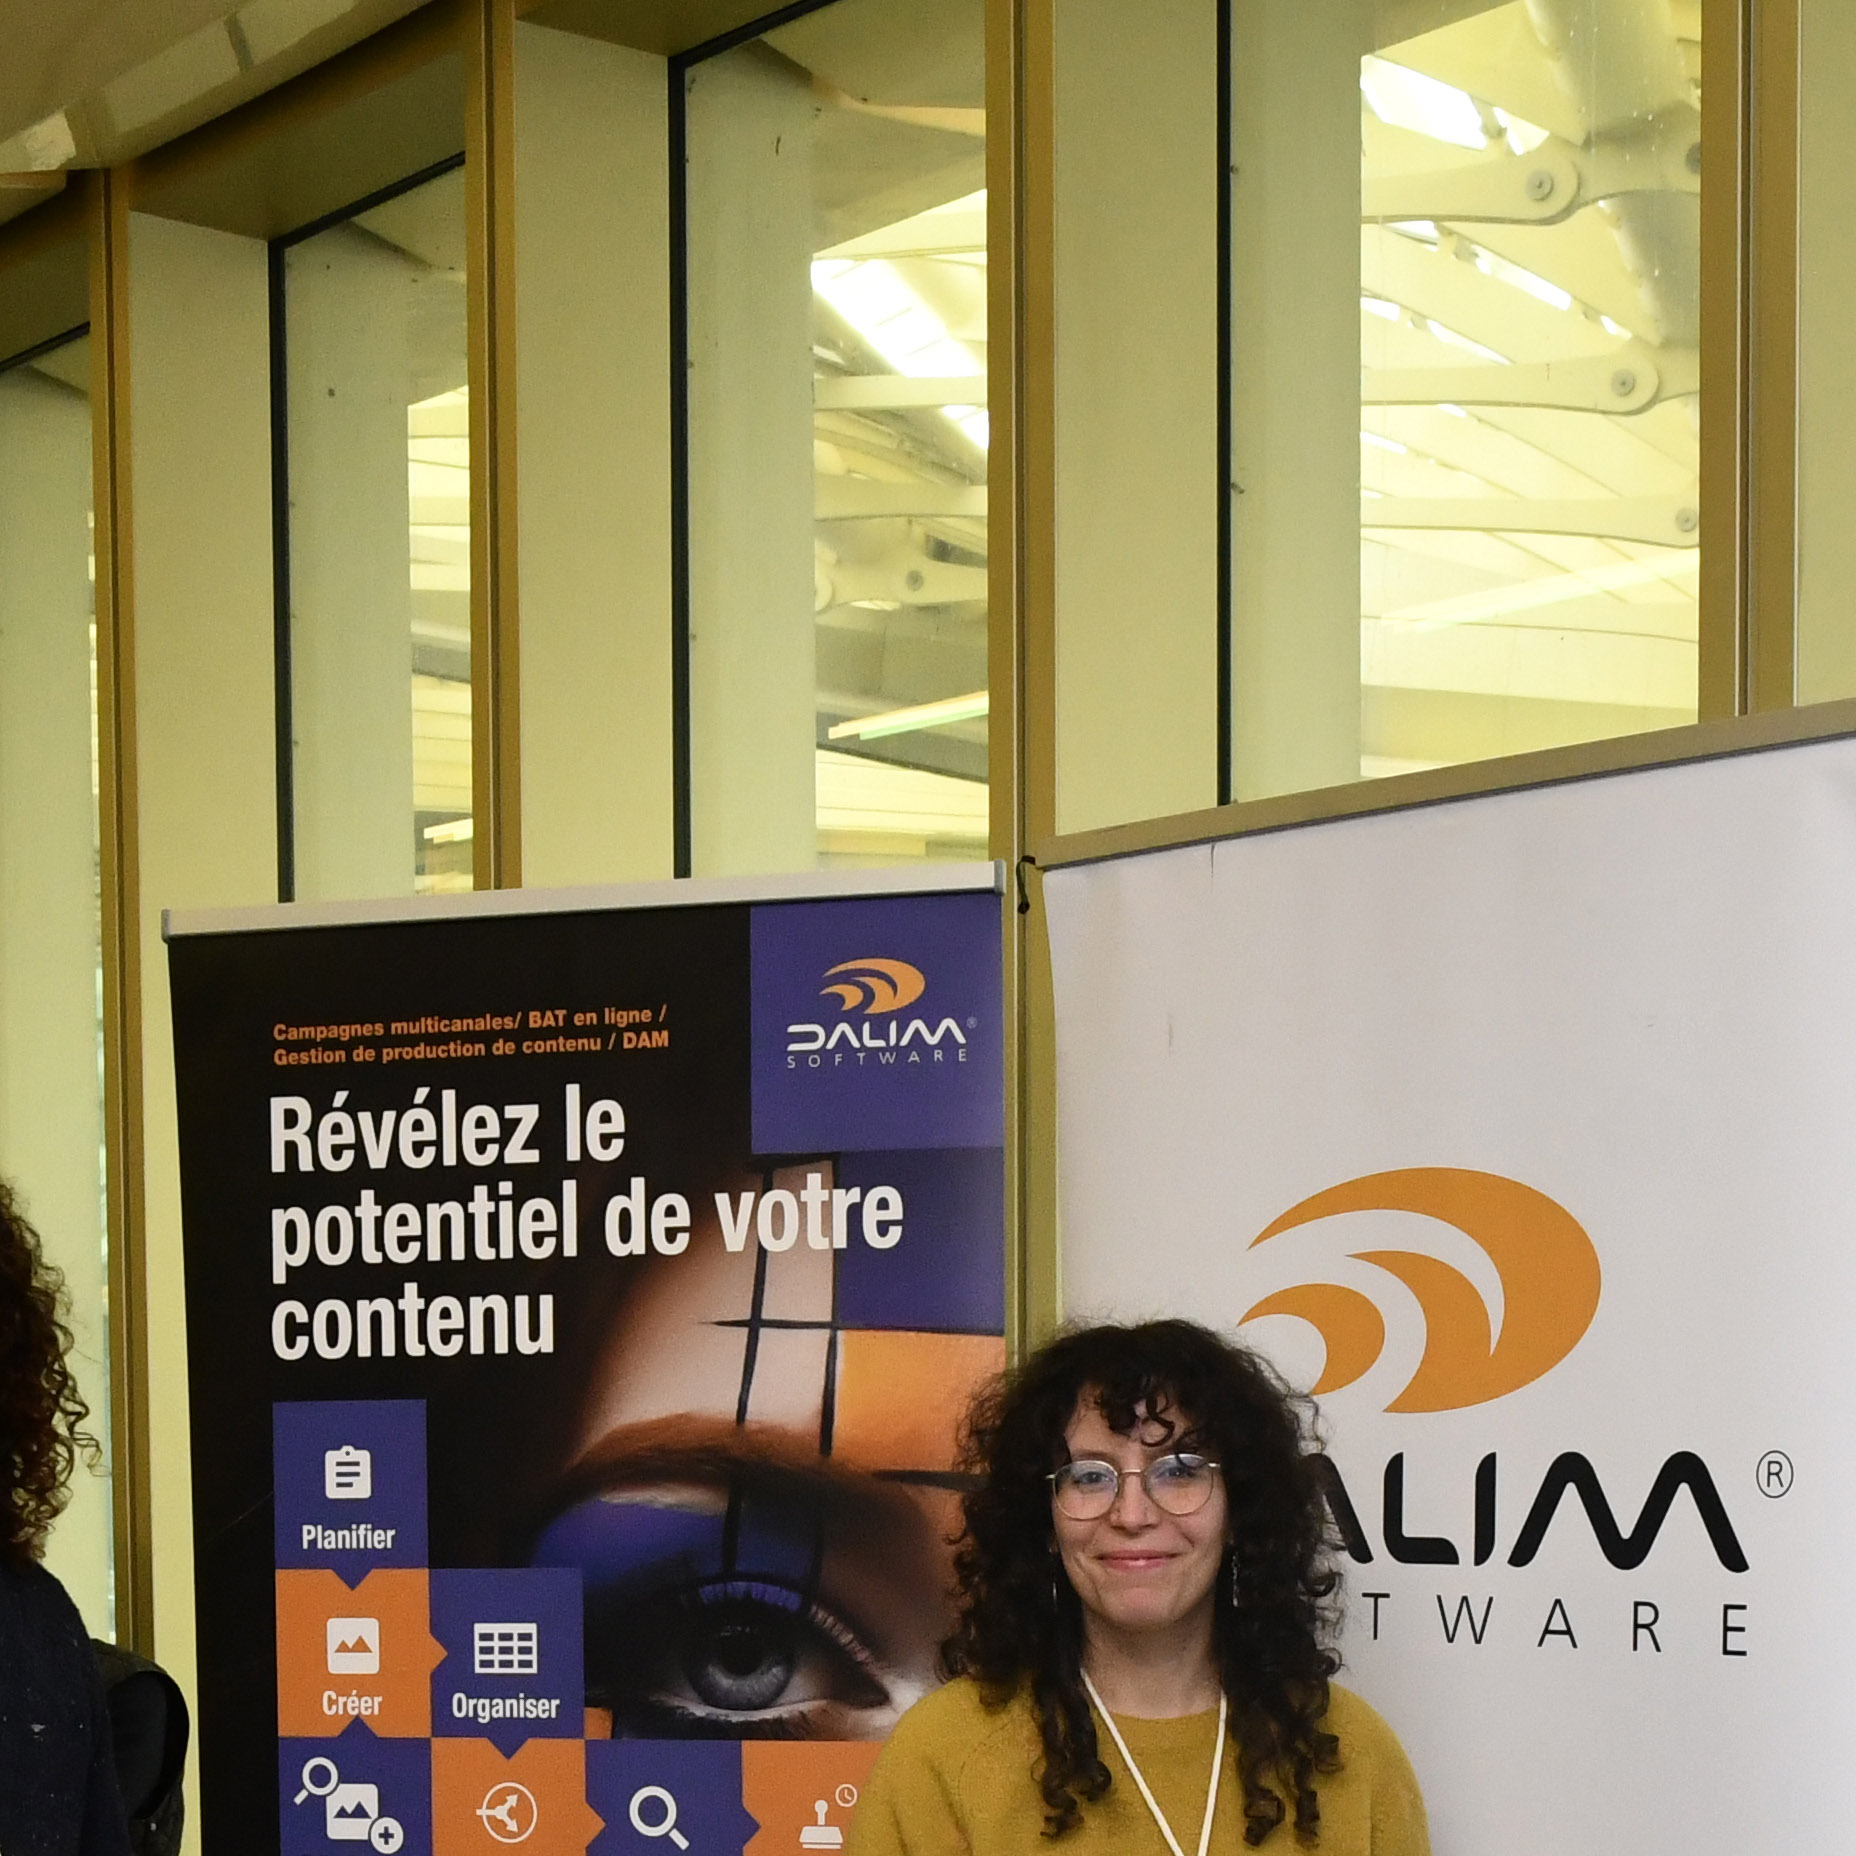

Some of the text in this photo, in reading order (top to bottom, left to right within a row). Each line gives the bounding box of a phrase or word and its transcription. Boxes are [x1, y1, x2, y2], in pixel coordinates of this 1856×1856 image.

[273, 1004, 668, 1043] Campagnes multicanales/ BAT en ligne /
[786, 1017, 966, 1052] DALIM
[273, 1030, 670, 1067] Gestion de production de contenu / DAM
[786, 1048, 967, 1069] SOFTWARE
[268, 1083, 625, 1173] Révélez le
[271, 1172, 904, 1285] potentiel de votre
[271, 1281, 555, 1361] contenu
[301, 1524, 396, 1551] Planifier
[321, 1690, 382, 1717] Créer
[451, 1693, 561, 1724] Organiser
